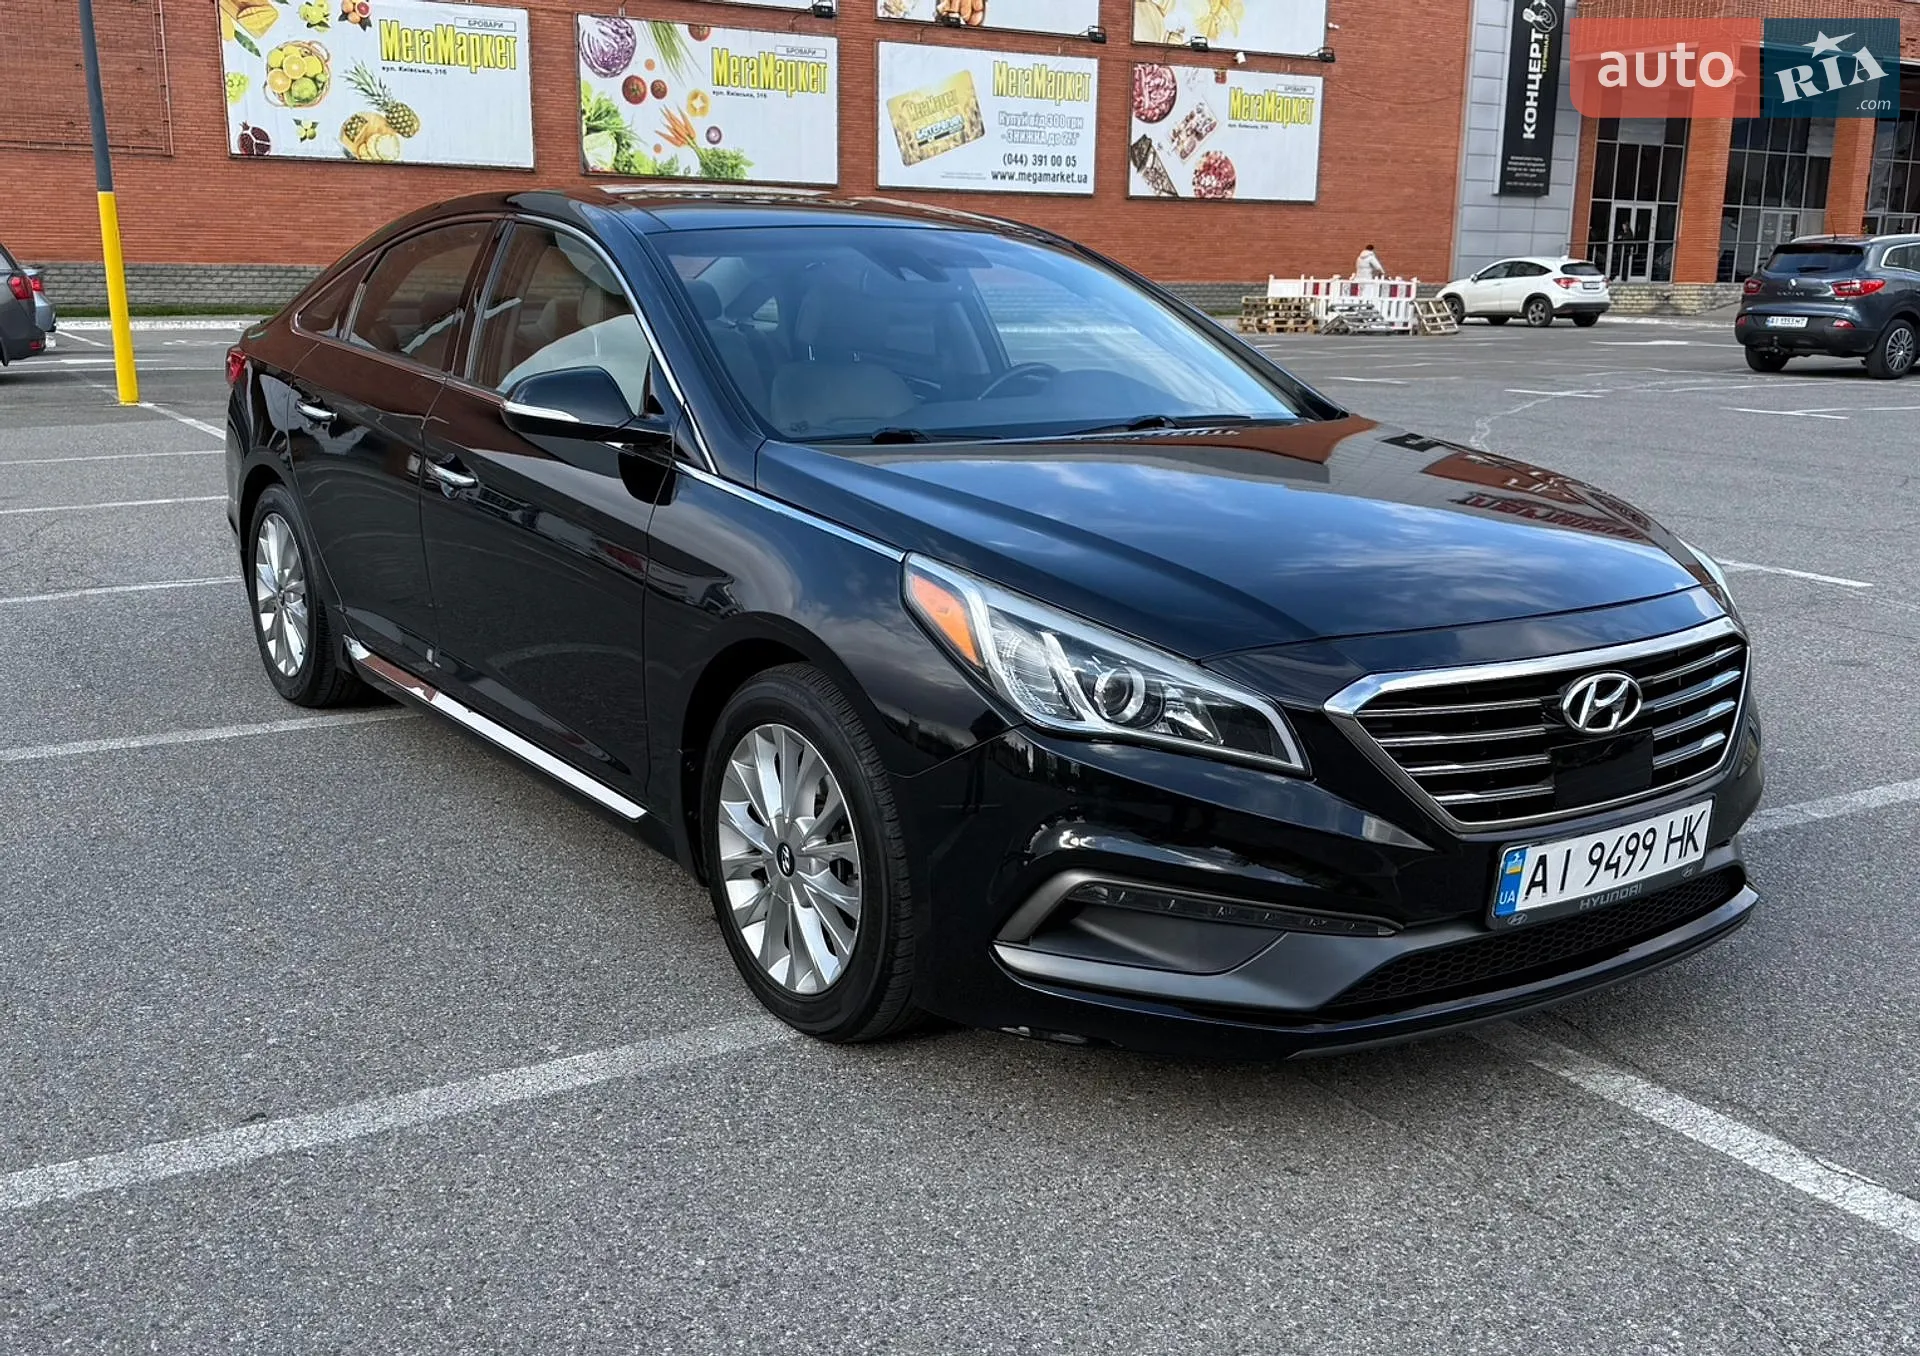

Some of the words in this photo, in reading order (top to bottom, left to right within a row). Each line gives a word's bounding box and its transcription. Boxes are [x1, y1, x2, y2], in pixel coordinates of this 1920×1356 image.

[468, 19, 504, 29] БРОВАРИ
[379, 19, 517, 74] МегаМаркет
[711, 47, 827, 98] МегаМаркет
[993, 61, 1091, 106] МегаМаркет
[1522, 28, 1543, 139] КОНЦЕРТ
[1046, 113, 1066, 128] 300
[1229, 87, 1314, 129] МегаМаркет
[991, 169, 1088, 184] www.megamarket.ua
[1002, 153, 1028, 167] (044)
[1031, 154, 1048, 167] 391
[1050, 155, 1063, 168] 00
[1065, 155, 1078, 168] 05
[1523, 848, 1572, 901] AI
[1583, 827, 1657, 888] 9499
[1662, 809, 1707, 864] HK
[1498, 889, 1516, 905] UA
[1578, 883, 1643, 911] HYUNDAI
